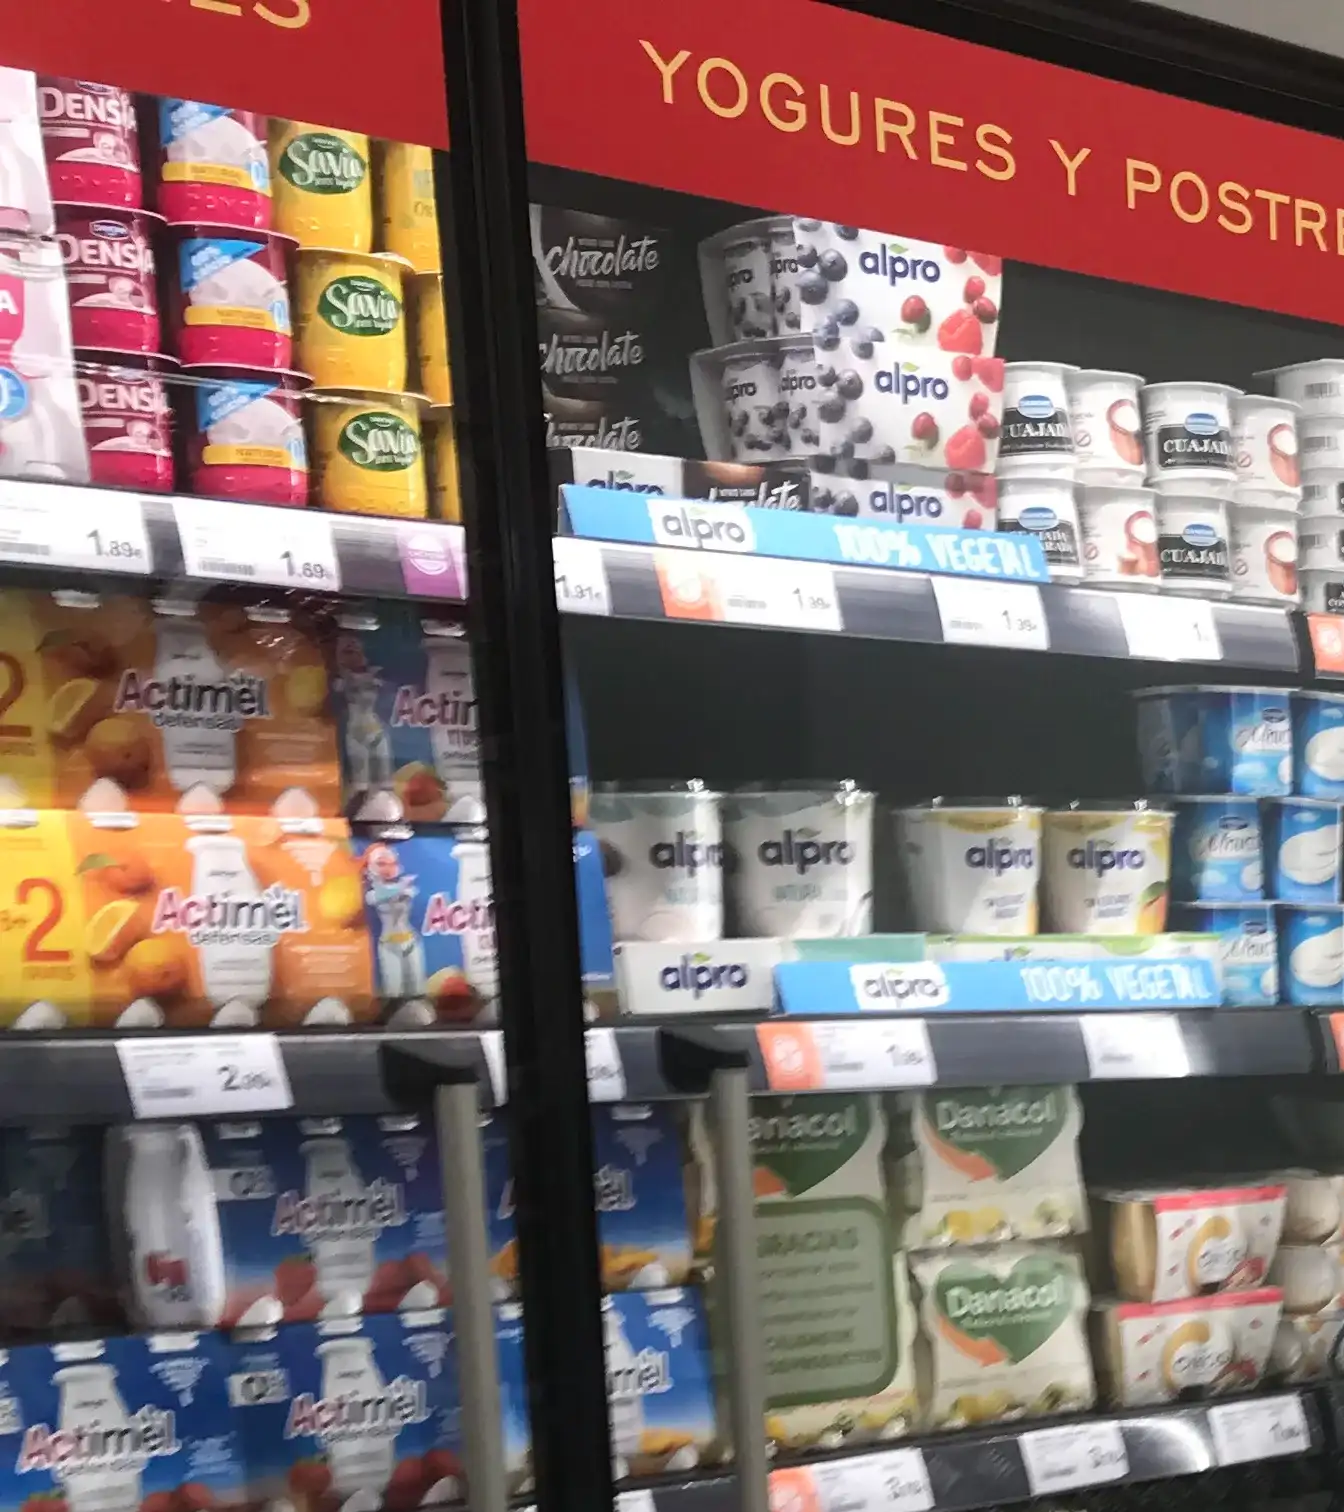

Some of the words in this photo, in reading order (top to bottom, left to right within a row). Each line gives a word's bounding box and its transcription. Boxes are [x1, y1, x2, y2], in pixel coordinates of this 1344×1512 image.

[639, 39, 1018, 182] YOGURES
[1049, 139, 1091, 198] Y
[286, 141, 367, 180] Savia
[545, 235, 660, 277] chocolate
[860, 244, 941, 286] alpro
[325, 283, 400, 323] Savia
[875, 363, 950, 404] alpro
[345, 421, 419, 462] Savia
[869, 479, 944, 522] alpro
[662, 508, 746, 549] alpro
[835, 524, 922, 567] 100%
[927, 533, 1040, 576] VEGETAL
[115, 670, 272, 720] Actimel
[393, 686, 477, 728] Acti
[758, 829, 855, 876] alpro
[965, 838, 1035, 877] alpro
[1066, 840, 1146, 879] alpro
[18, 878, 70, 961] 2
[154, 886, 308, 935] Actimel
[660, 954, 748, 999] alpro
[865, 972, 942, 1008] alpro
[1020, 966, 1103, 1001] 100%
[1106, 964, 1211, 1001] VEGETAL
[748, 1105, 856, 1140] anacol
[936, 1090, 1055, 1131] Danacol
[946, 1278, 1065, 1318] Danacol
[286, 1375, 428, 1439] Actimel
[19, 1406, 180, 1474] Actimel
